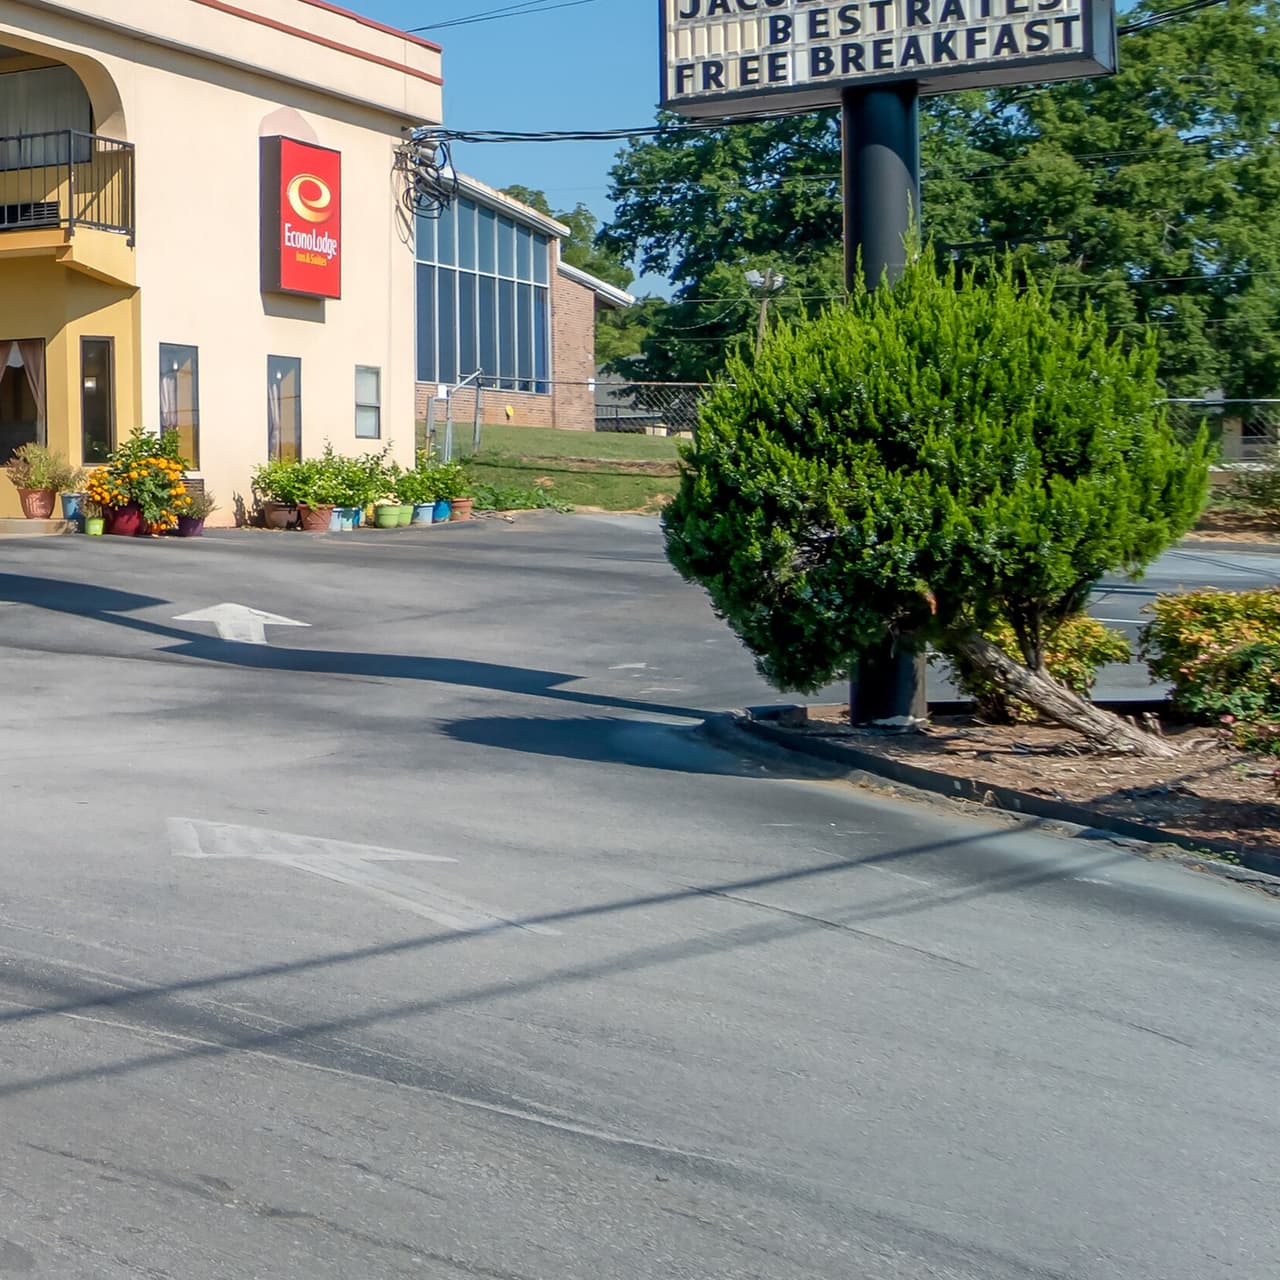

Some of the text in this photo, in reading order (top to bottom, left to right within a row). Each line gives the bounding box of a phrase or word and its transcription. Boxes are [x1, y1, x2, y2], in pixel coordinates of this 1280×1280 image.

[769, 0, 894, 46] BEST
[675, 14, 1080, 95] FREE BREAKFAST
[284, 222, 338, 260] EconoLodge
